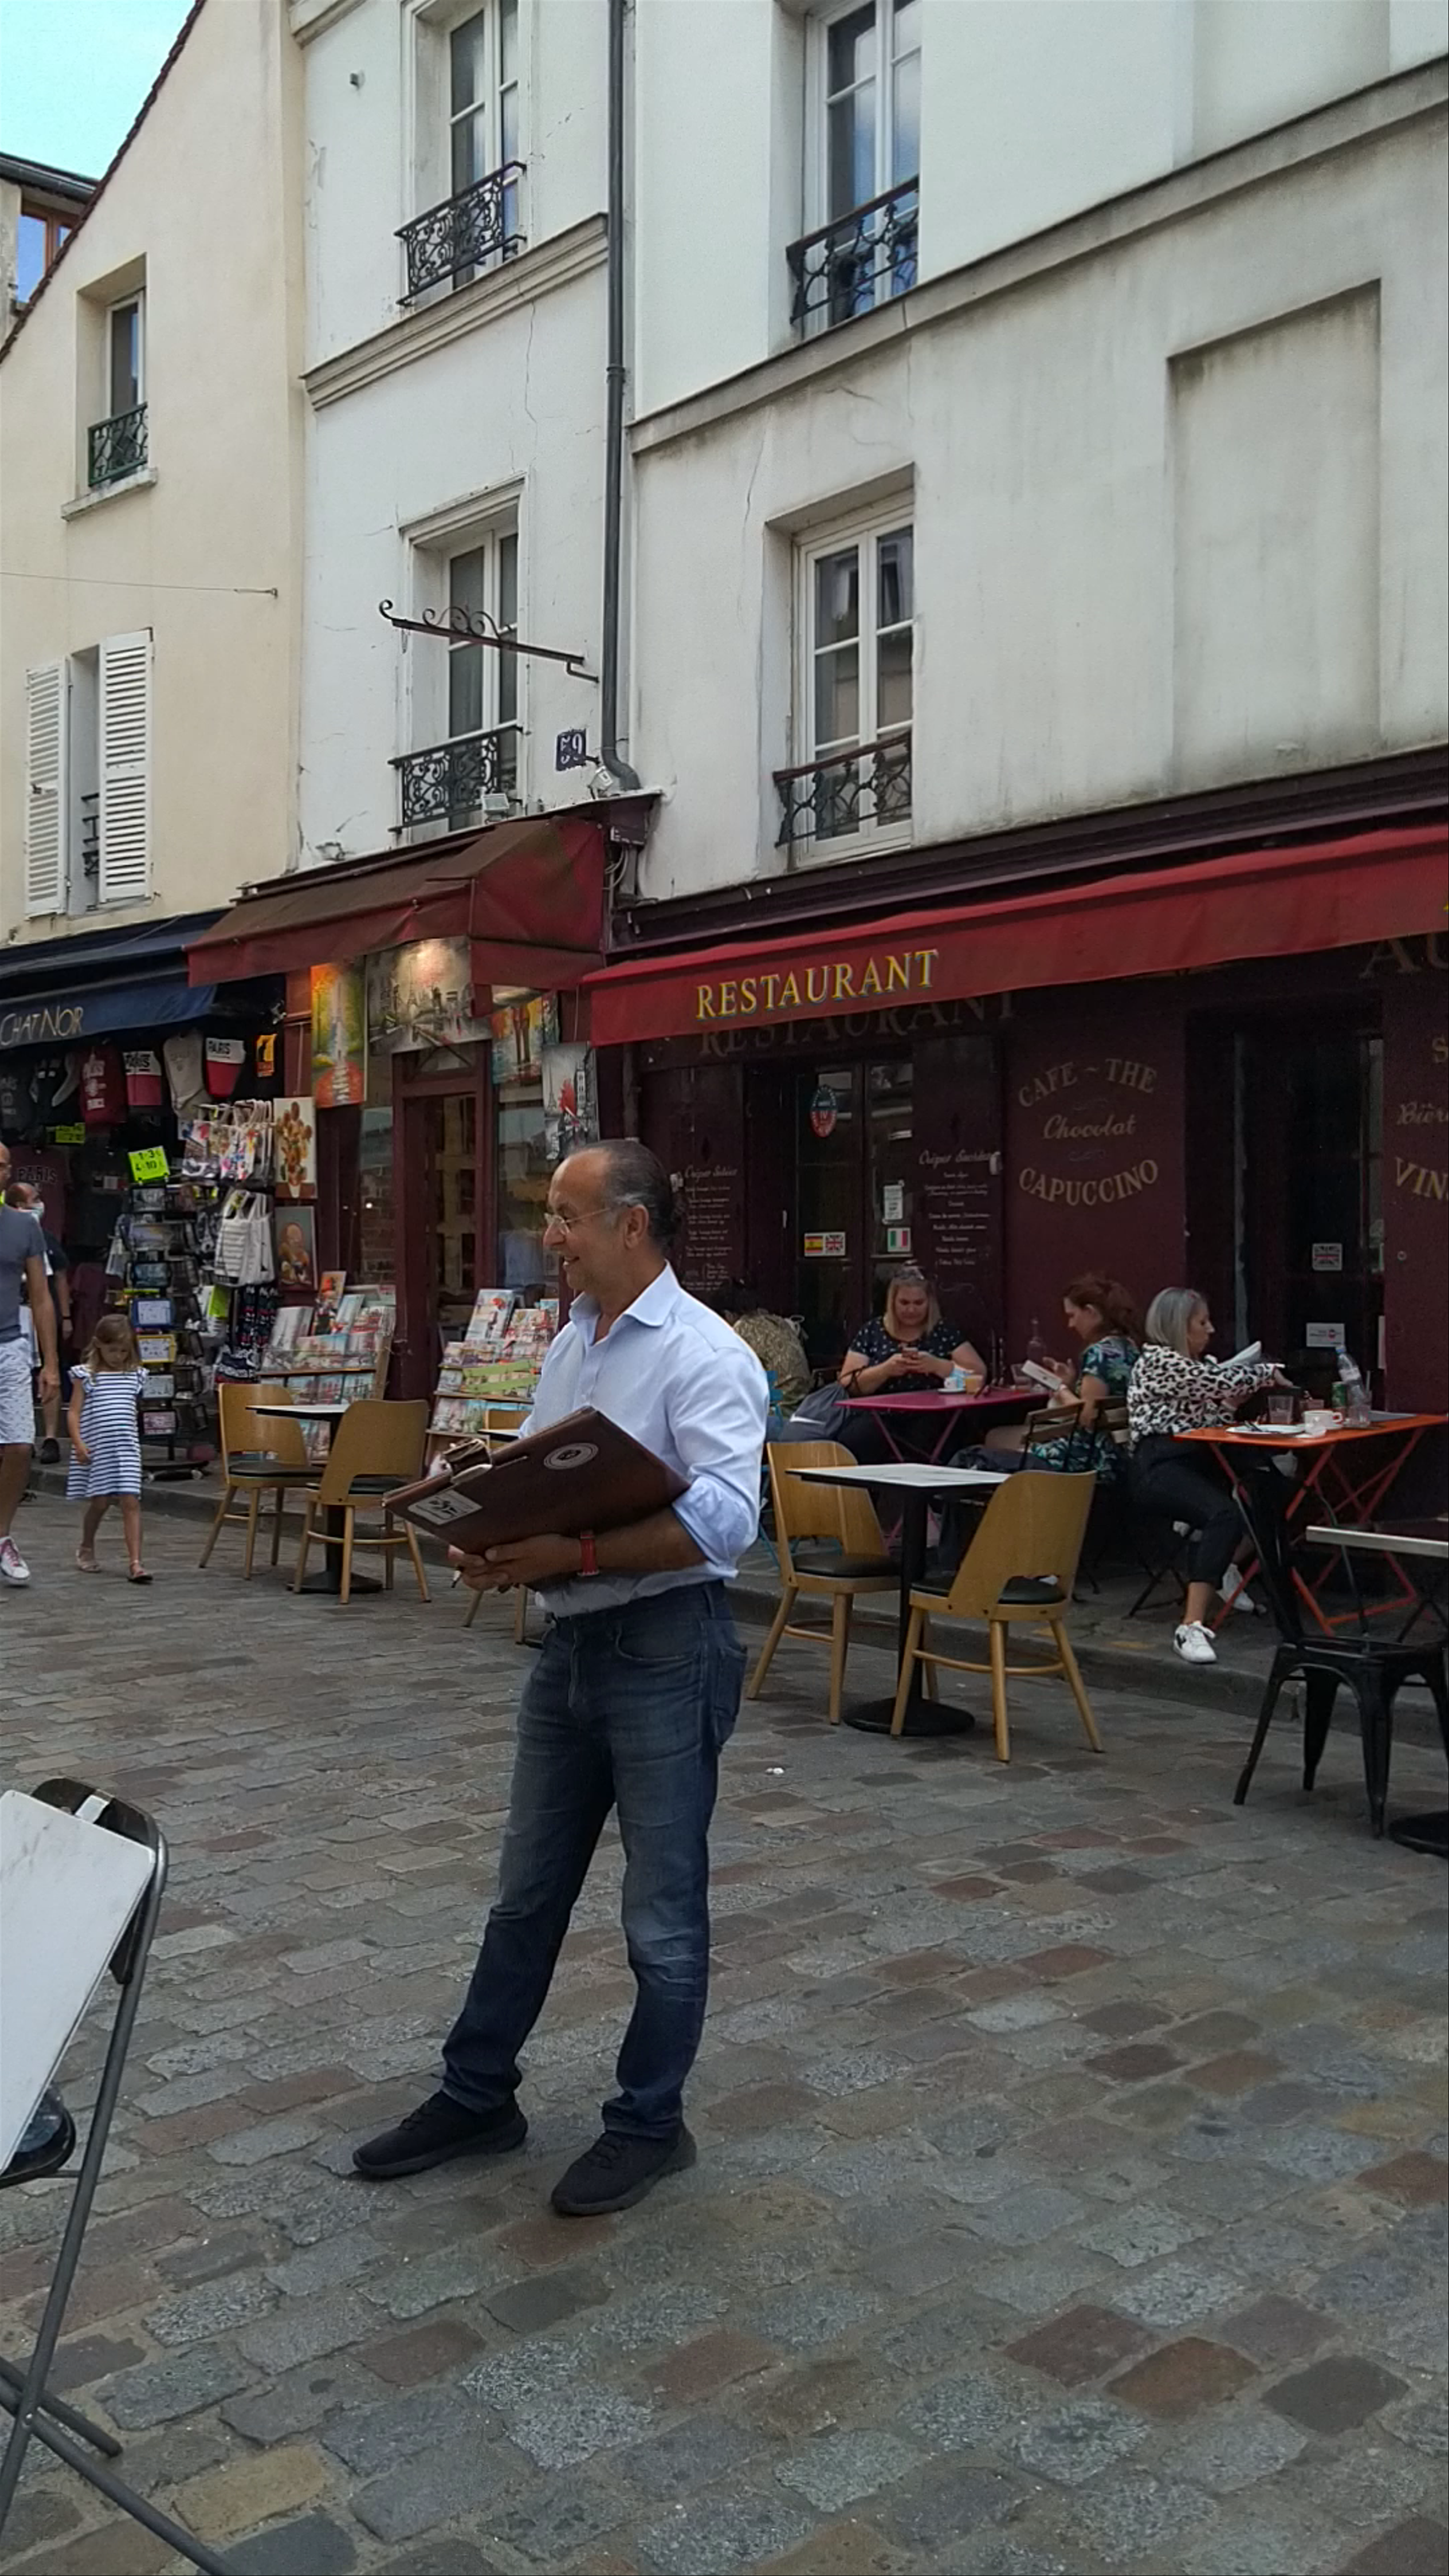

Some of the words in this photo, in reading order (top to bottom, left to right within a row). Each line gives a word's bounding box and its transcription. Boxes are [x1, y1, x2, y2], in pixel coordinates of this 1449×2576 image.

[695, 949, 939, 1020] RESTAURANT
[0, 1013, 42, 1046] CHAT
[1018, 1061, 1078, 1107] CAFE
[1105, 1058, 1157, 1093] THE
[1043, 1114, 1137, 1139] Chocolat
[17, 1165, 59, 1184] PARIS
[1019, 1159, 1159, 1206] CAPUCCINO
[1395, 1157, 1449, 1201] VIN
